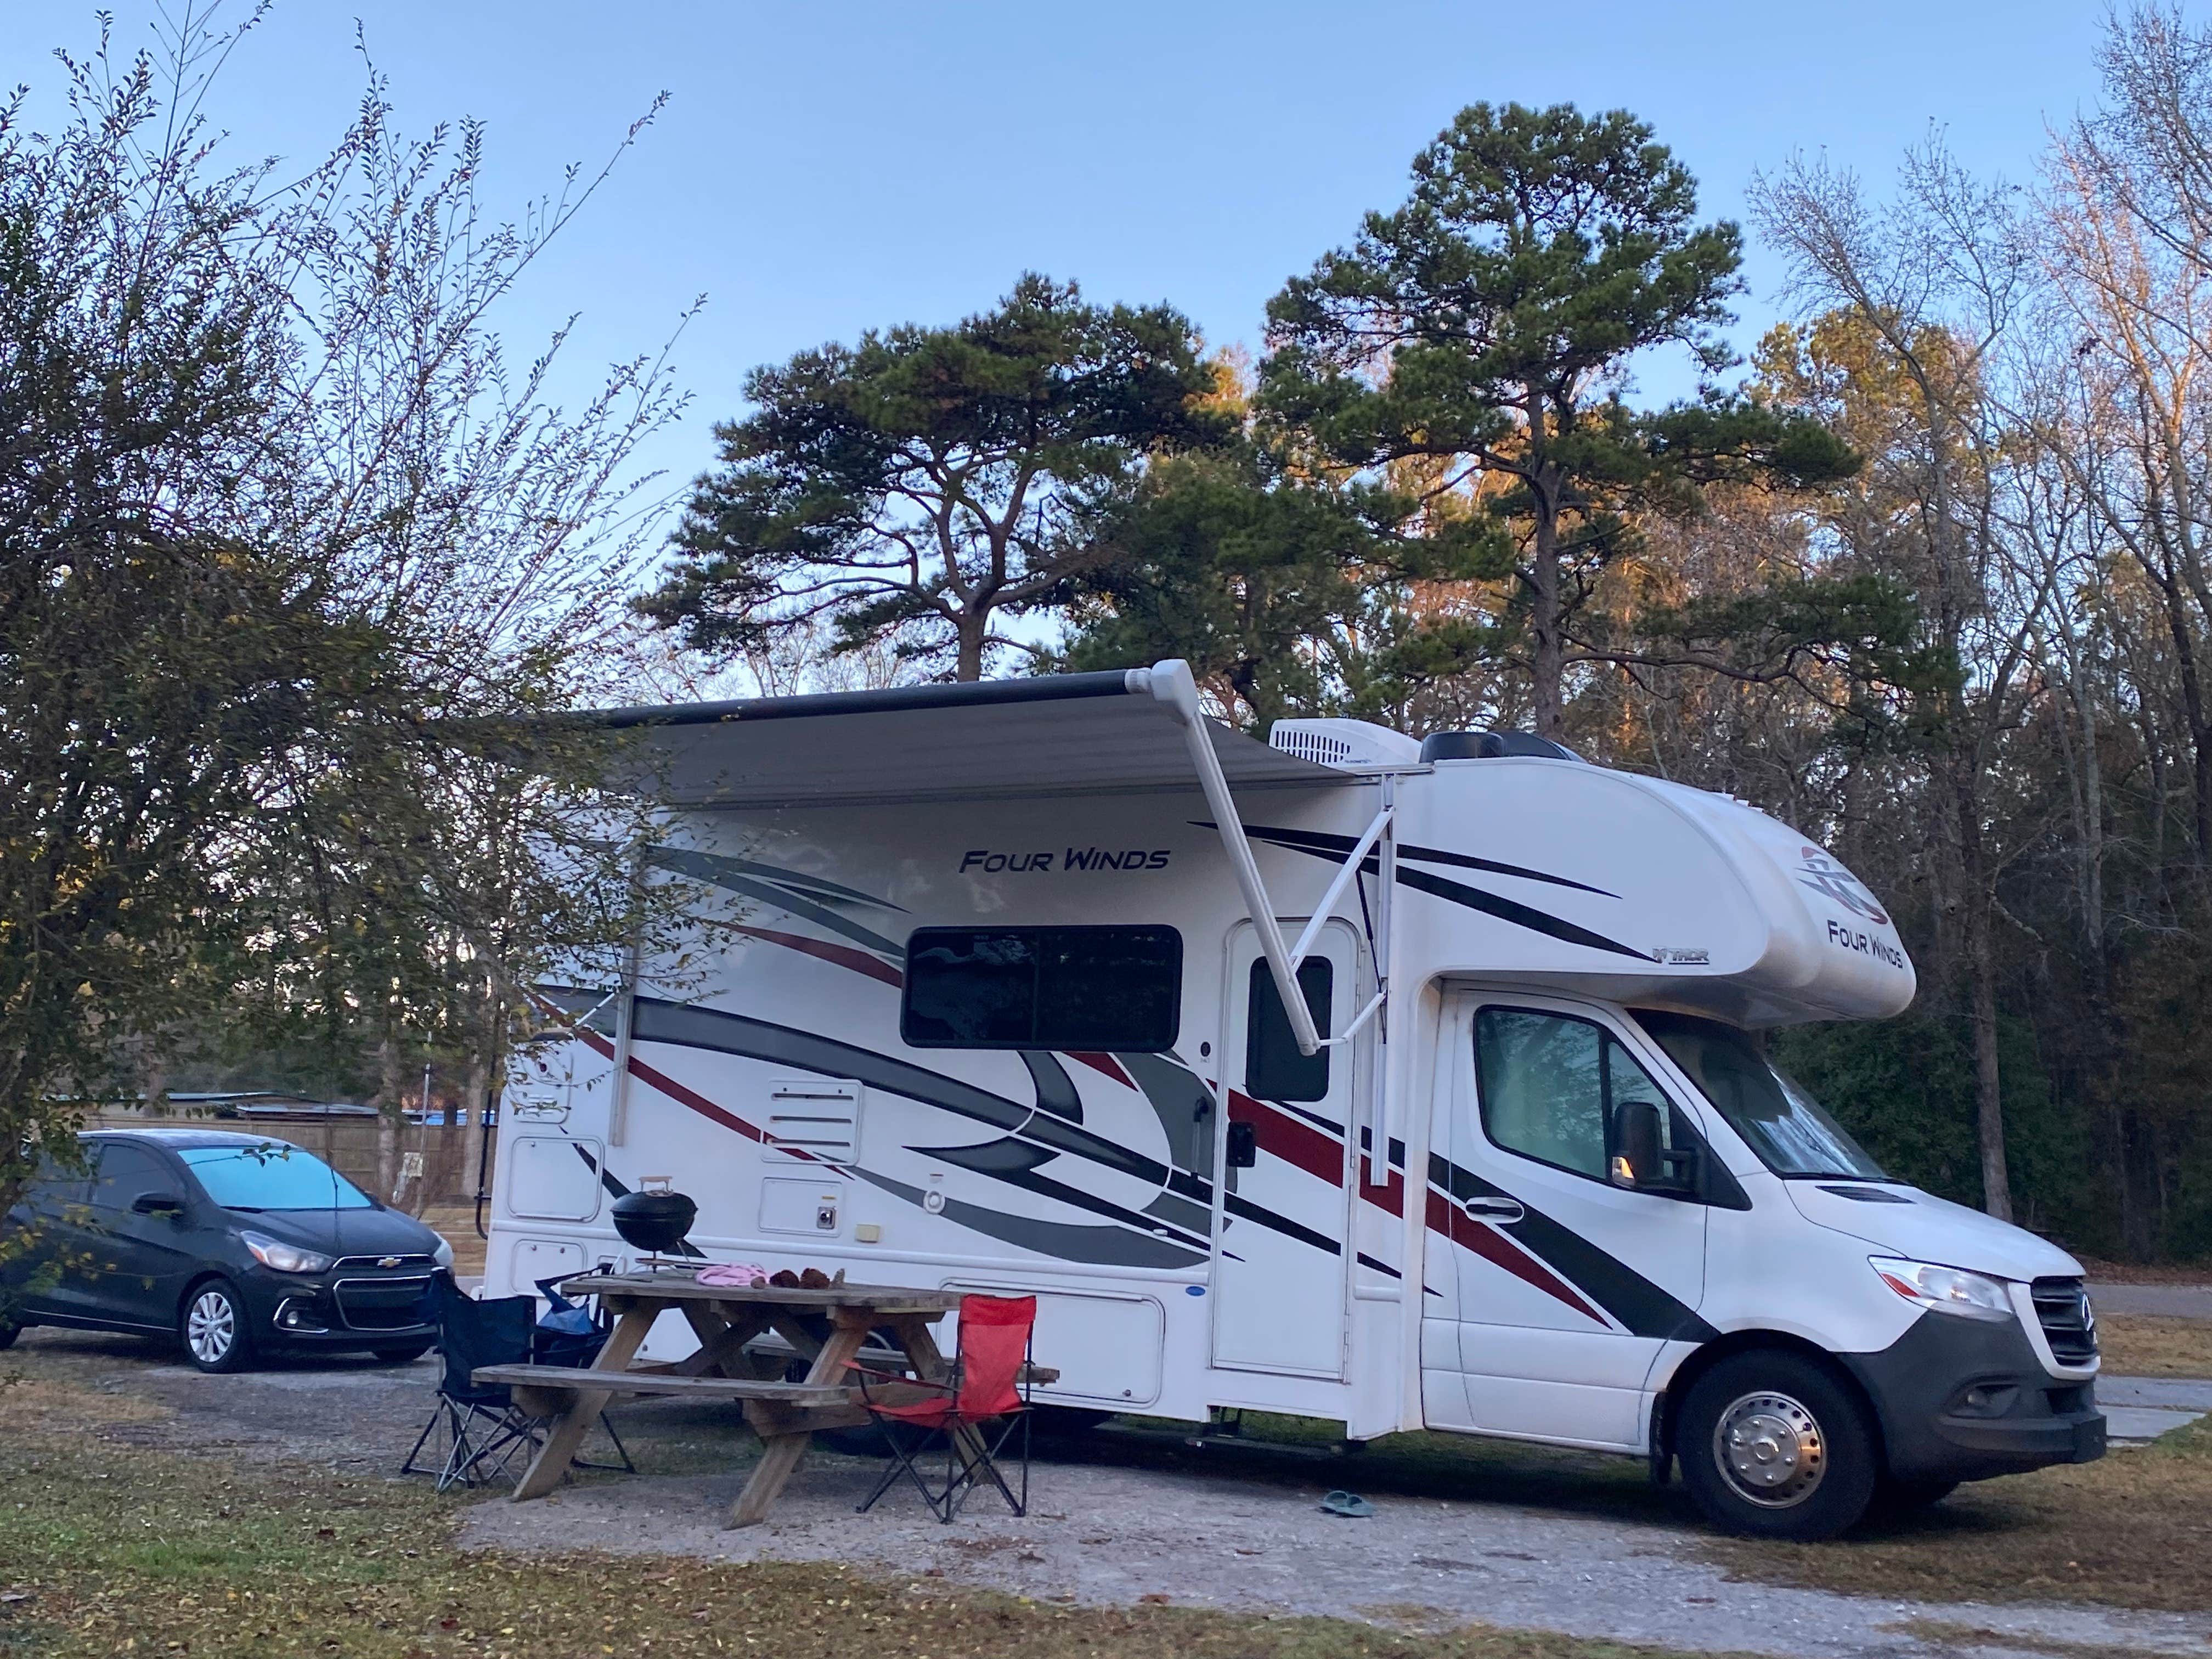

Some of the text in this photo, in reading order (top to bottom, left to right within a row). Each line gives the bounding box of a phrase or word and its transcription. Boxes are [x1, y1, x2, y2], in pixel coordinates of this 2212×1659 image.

[958, 847, 1171, 873] FOUR WINDS
[1827, 919, 1903, 969] FOUR WINDS
